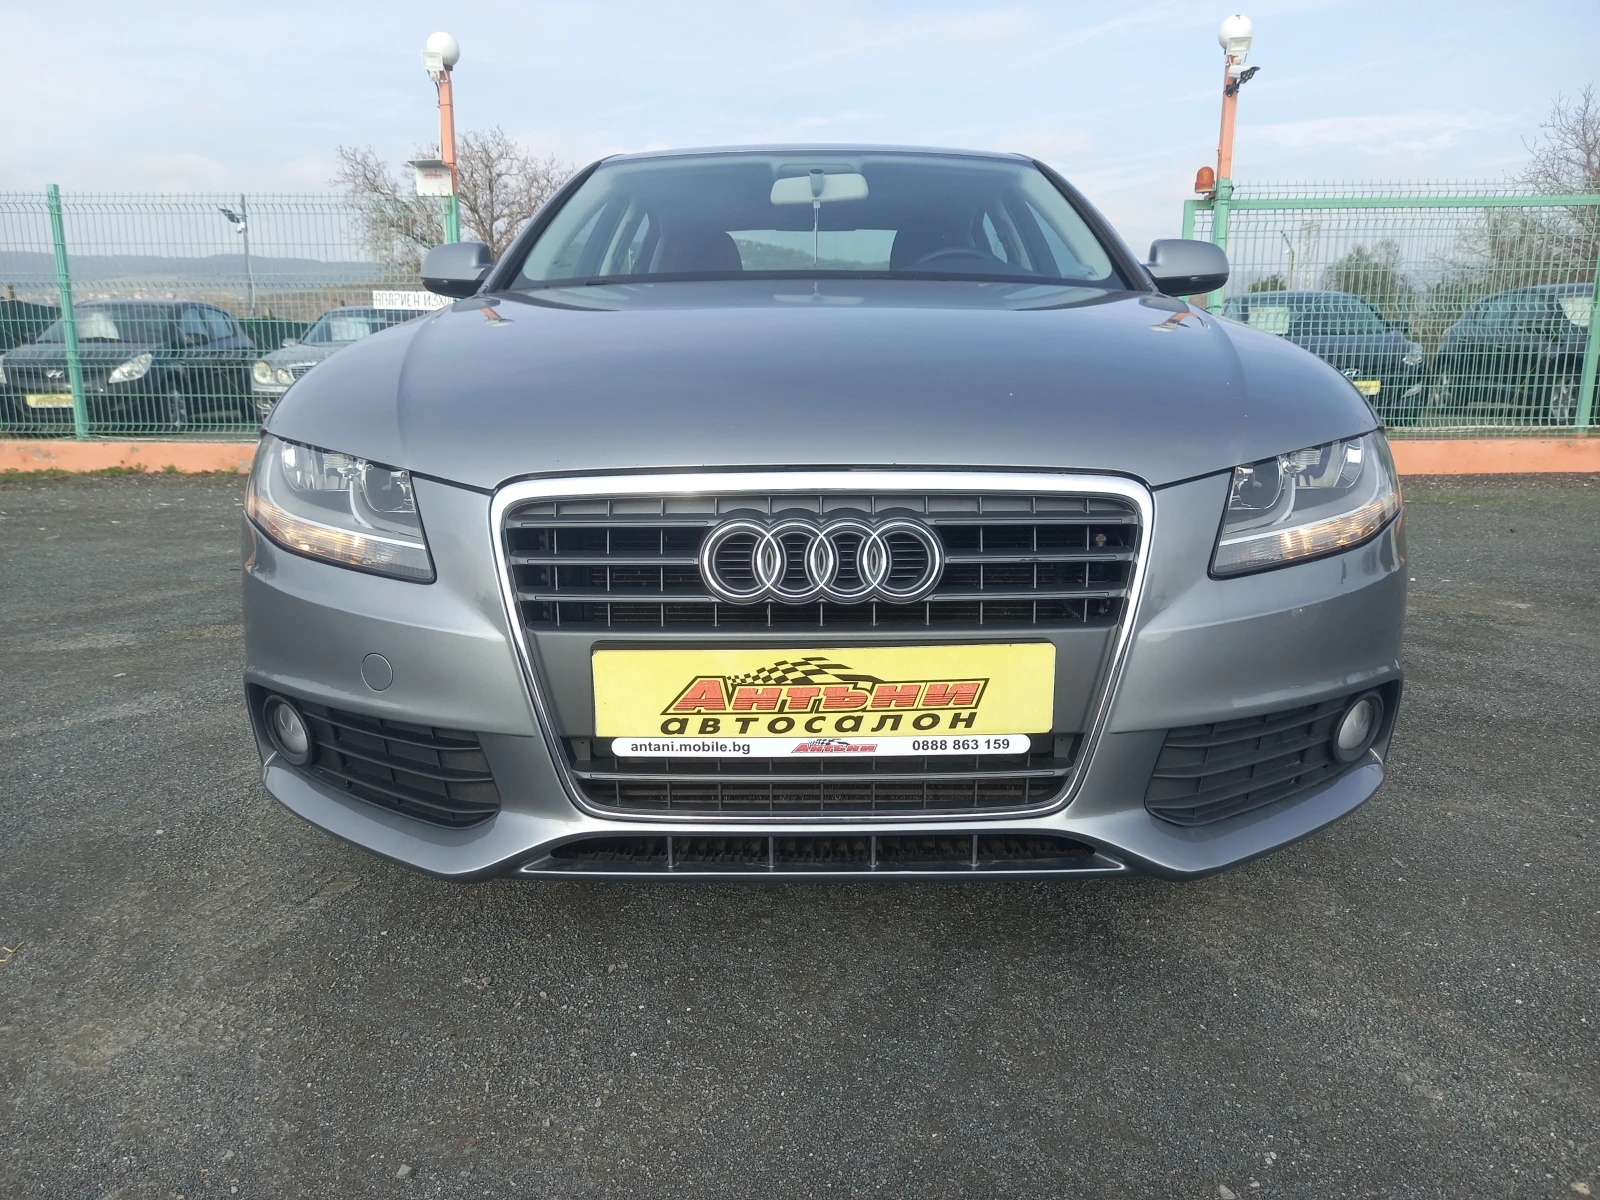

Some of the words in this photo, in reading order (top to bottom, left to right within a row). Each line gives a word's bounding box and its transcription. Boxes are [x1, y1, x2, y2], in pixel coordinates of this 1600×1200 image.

[660, 711, 978, 735] автосалон
[630, 741, 751, 755] antani.mobile.bg
[912, 739, 948, 751] 0888
[952, 739, 979, 750] 863
[984, 738, 1010, 750] 159
